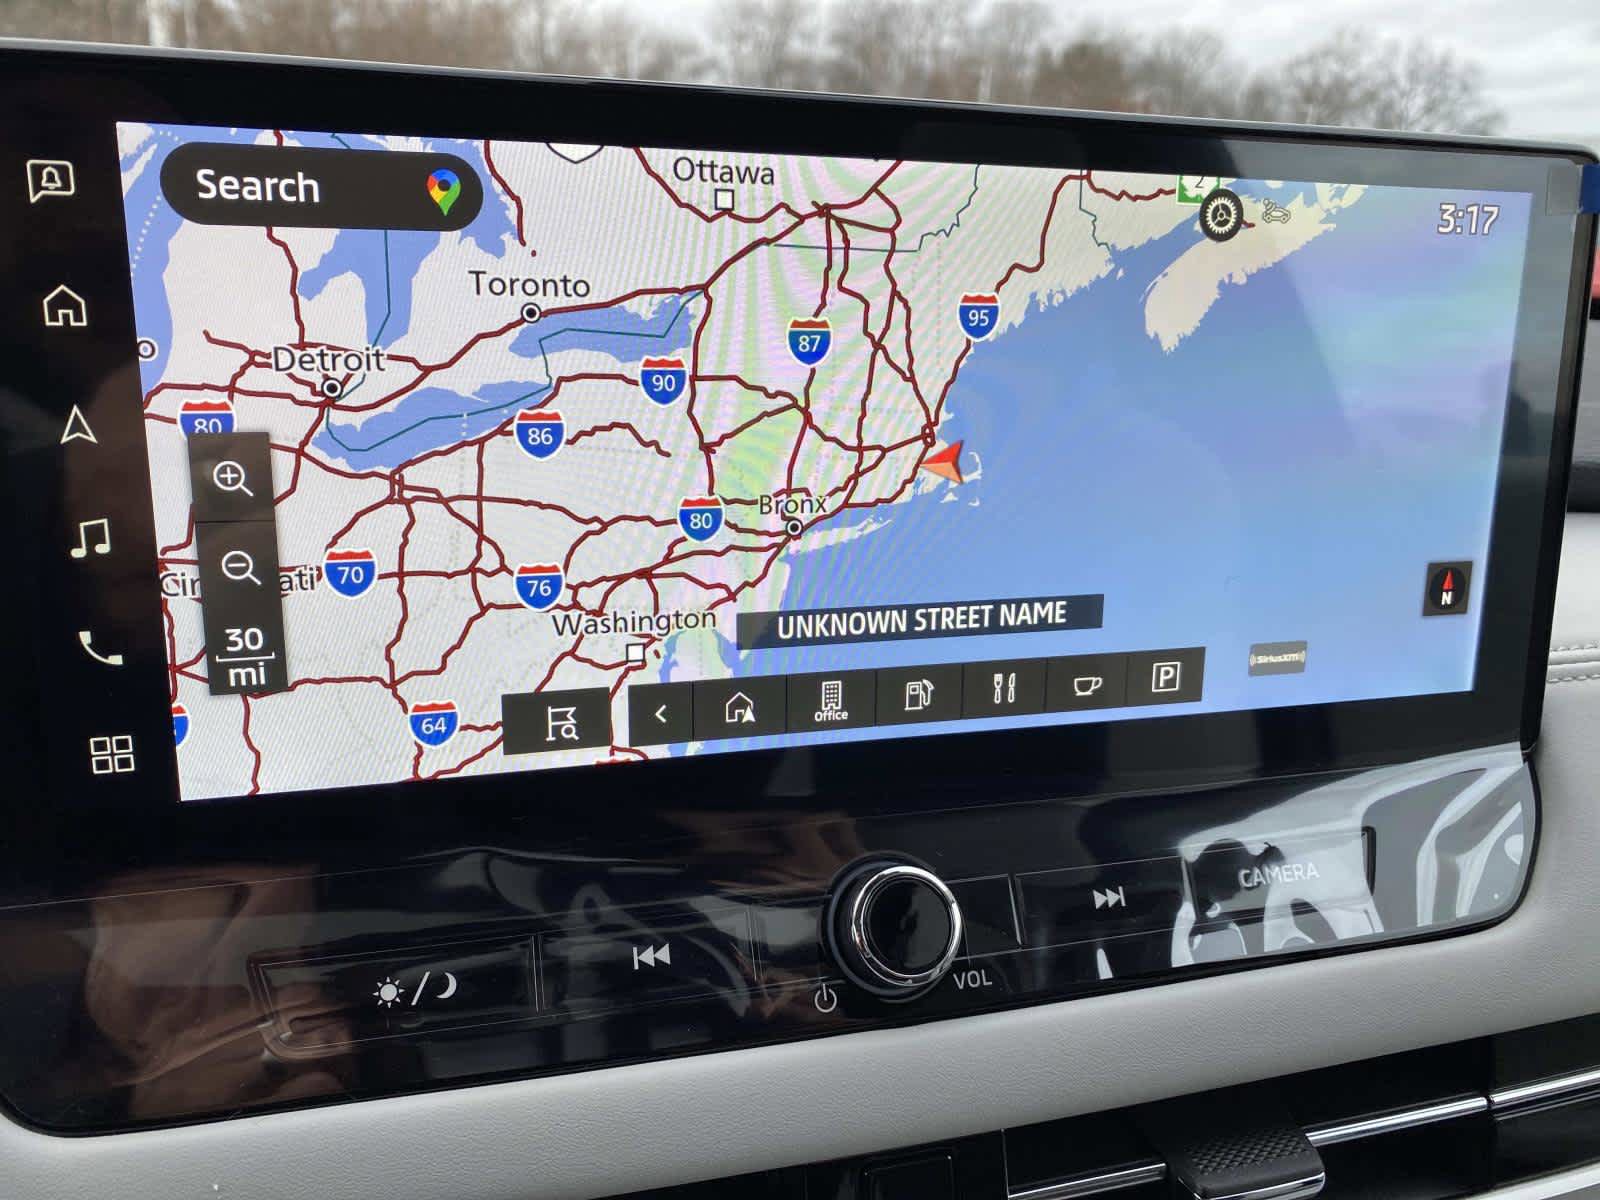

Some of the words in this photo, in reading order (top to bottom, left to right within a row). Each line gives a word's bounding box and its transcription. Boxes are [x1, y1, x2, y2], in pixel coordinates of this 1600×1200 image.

[672, 156, 775, 186] Ottawa
[196, 168, 320, 203] Search
[1437, 203, 1500, 236] 3:17
[468, 270, 591, 298] Toronto
[967, 308, 990, 328] 95
[797, 335, 821, 353] 87
[273, 346, 386, 373] Detroit
[651, 373, 676, 392] 90
[193, 417, 222, 433] 80
[527, 426, 553, 446] 86
[759, 495, 827, 516] Bronx
[689, 512, 713, 531] 80
[337, 565, 364, 585] 70
[526, 577, 552, 598] 76
[1441, 590, 1452, 605] N
[552, 607, 716, 636] Washington
[778, 611, 908, 638] UNKNOWN
[914, 605, 993, 631] STREET
[1000, 601, 1068, 626] NAME
[225, 628, 264, 651] 30
[229, 662, 266, 688] mi
[421, 716, 449, 736] 64
[814, 709, 849, 722] Office
[1238, 864, 1320, 886] CAMERA
[953, 969, 993, 989] VOL
